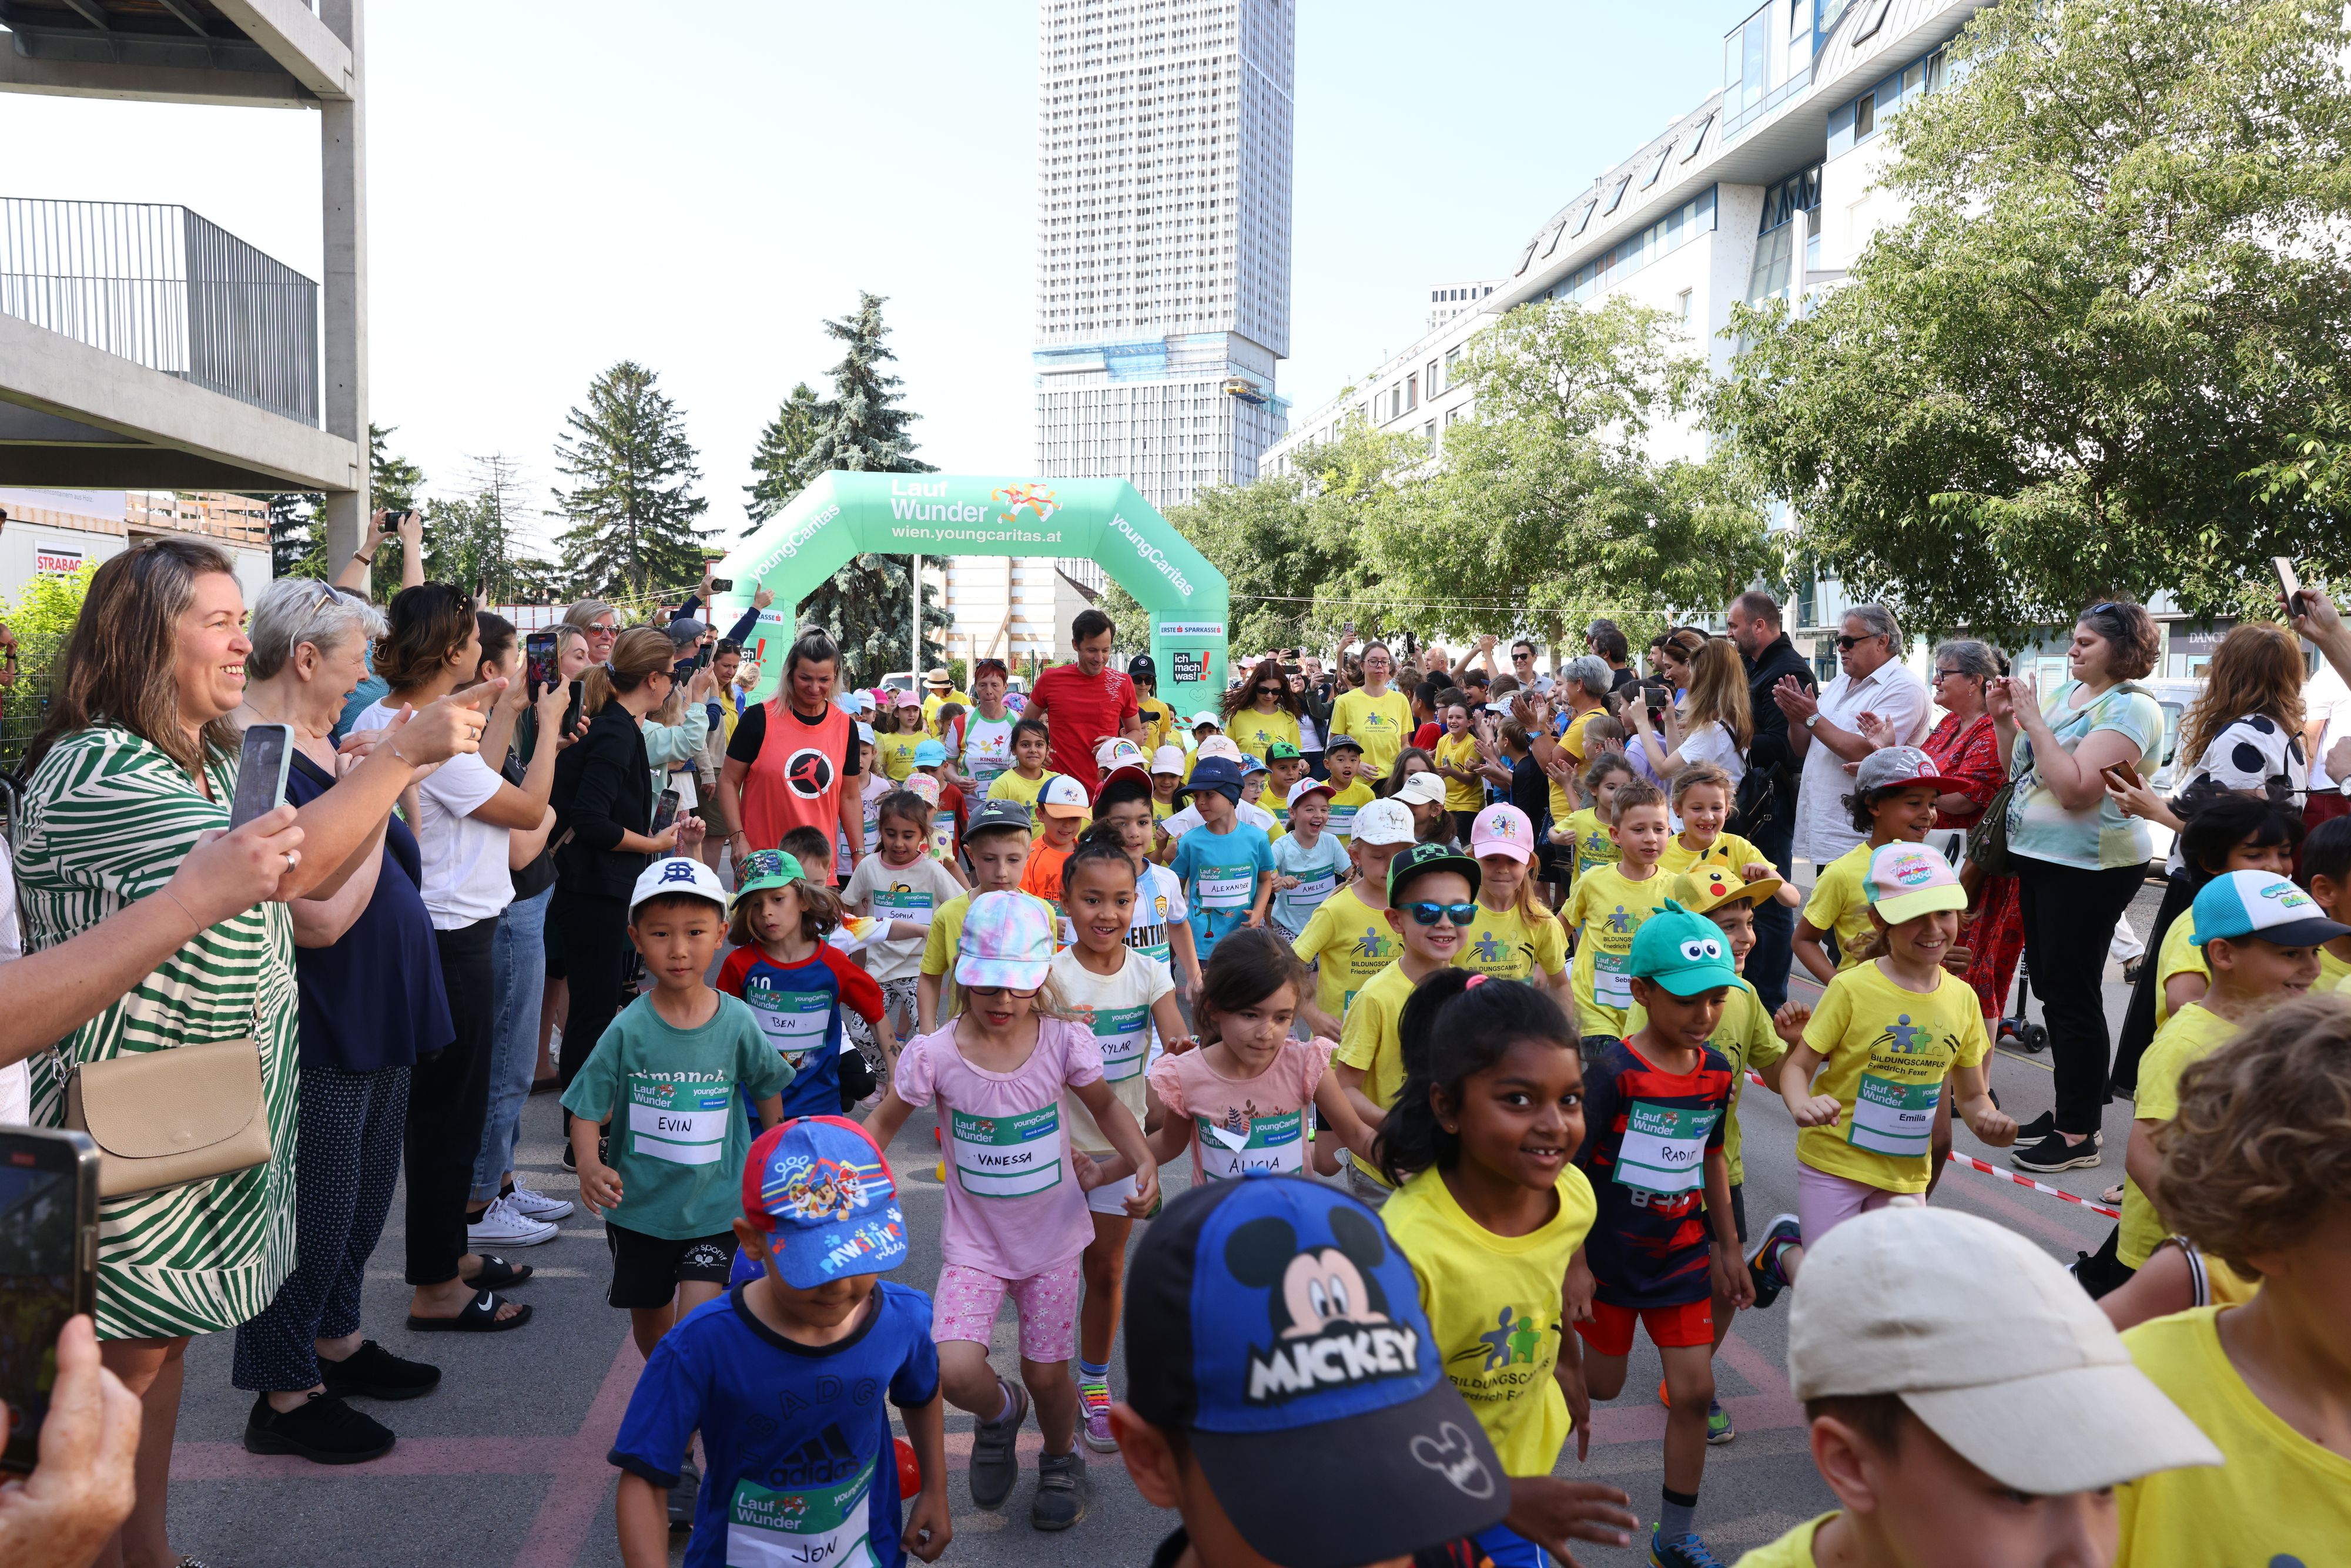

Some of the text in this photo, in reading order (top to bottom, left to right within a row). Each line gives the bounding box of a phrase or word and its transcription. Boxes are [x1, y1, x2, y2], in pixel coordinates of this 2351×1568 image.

[892, 479, 948, 497] Lauf
[890, 498, 988, 522] Wunder
[892, 525, 1061, 542] wien.youngcaritas.at
[749, 504, 840, 584] youngCaritas
[1108, 512, 1194, 596] youngCaritas
[1175, 654, 1188, 663] ich
[1175, 663, 1200, 671] mach
[1175, 672, 1197, 680] was!
[863, 800, 878, 812] PION
[1211, 882, 1248, 893] ALEXANDER
[1302, 882, 1324, 893] AMELIE
[889, 911, 913, 919] SOPHIA
[1596, 956, 1609, 964] Lauf
[1596, 963, 1620, 972] Wunder
[751, 976, 771, 990] 10
[751, 990, 829, 1003] Lauf youngCaritas
[751, 997, 779, 1010] Wunder
[773, 1017, 795, 1028] BEN
[1112, 1010, 1144, 1022] youngCaritas
[1868, 1062, 1905, 1074] Friedrich
[1871, 1053, 1945, 1068] BILDUNGSCAMPUS
[634, 1083, 729, 1097] Lauf youngCaritas
[1864, 1080, 1888, 1094] Lauf
[634, 1093, 672, 1108] Wunder
[1863, 1088, 1903, 1107] Wunder
[956, 1110, 1056, 1131] Lauf youngCaritas
[1635, 1109, 1662, 1123] Lauf
[1899, 1114, 1926, 1122] Emilia
[658, 1117, 692, 1132] EVIN
[1255, 1117, 1300, 1133] youngCaritas
[1633, 1118, 1674, 1136] Wunder
[956, 1127, 993, 1143] Wunder
[978, 1152, 1032, 1167] VANESSA
[701, 1244, 728, 1261] sportif
[819, 1223, 902, 1275] PAWSITIVE
[875, 1241, 906, 1261] vibes
[1249, 1326, 1418, 1401] MICKEY
[769, 1457, 860, 1487] adidas
[738, 1492, 775, 1513] Lauf
[736, 1507, 802, 1530] Wunder
[792, 1536, 838, 1563] JON
